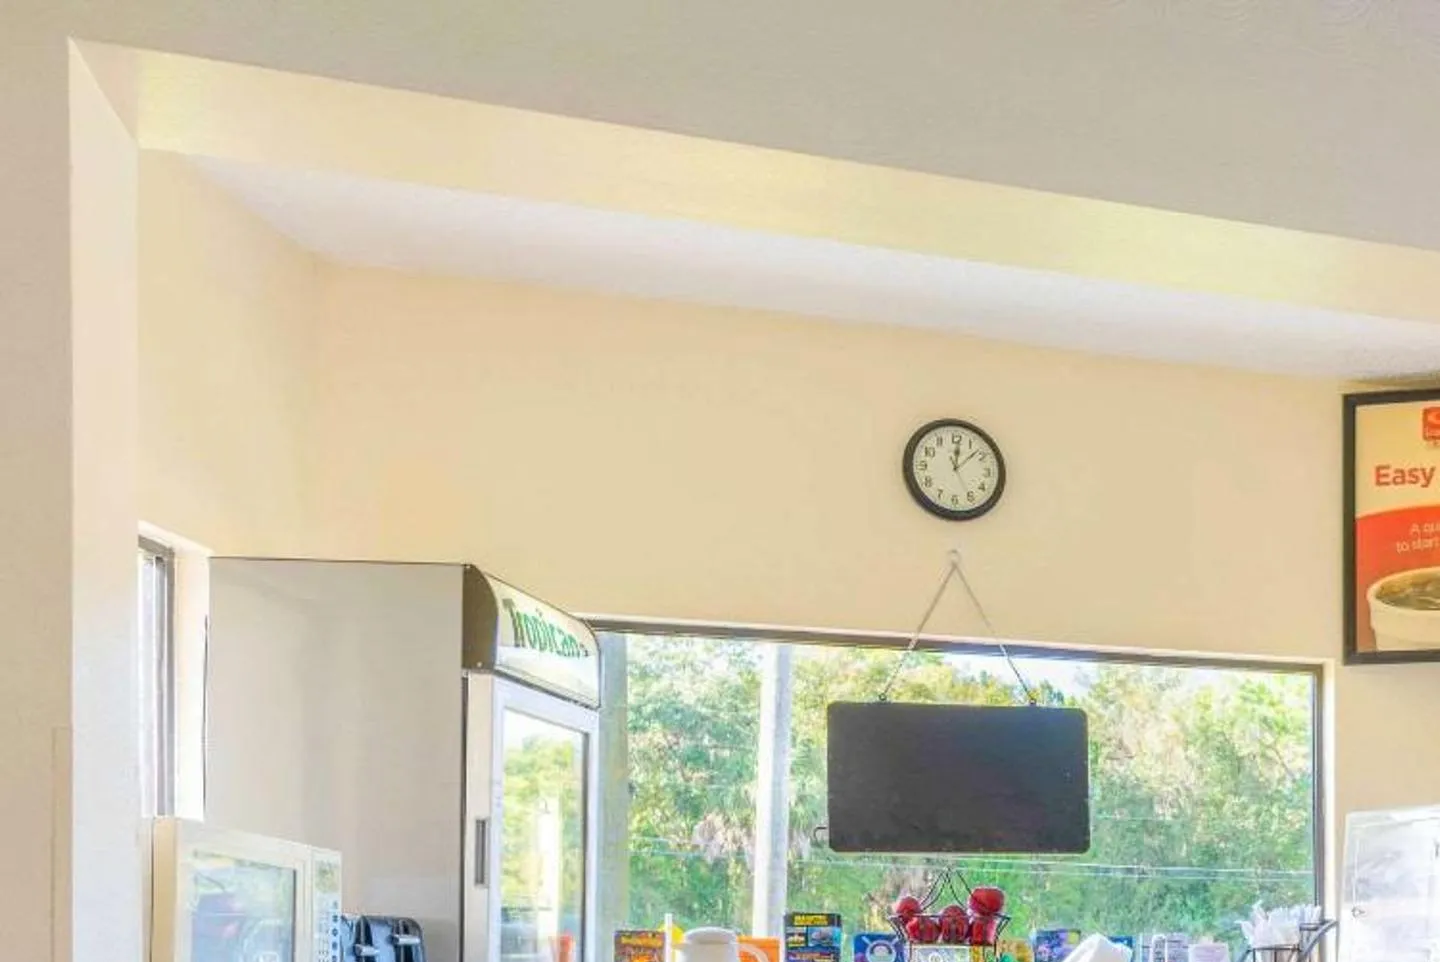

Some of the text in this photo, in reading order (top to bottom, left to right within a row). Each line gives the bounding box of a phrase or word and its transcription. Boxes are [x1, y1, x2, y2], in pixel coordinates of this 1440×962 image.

[1374, 464, 1436, 488] Easy
[1409, 523, 1419, 535] A
[1396, 541, 1410, 554] to
[1412, 537, 1440, 551] start
